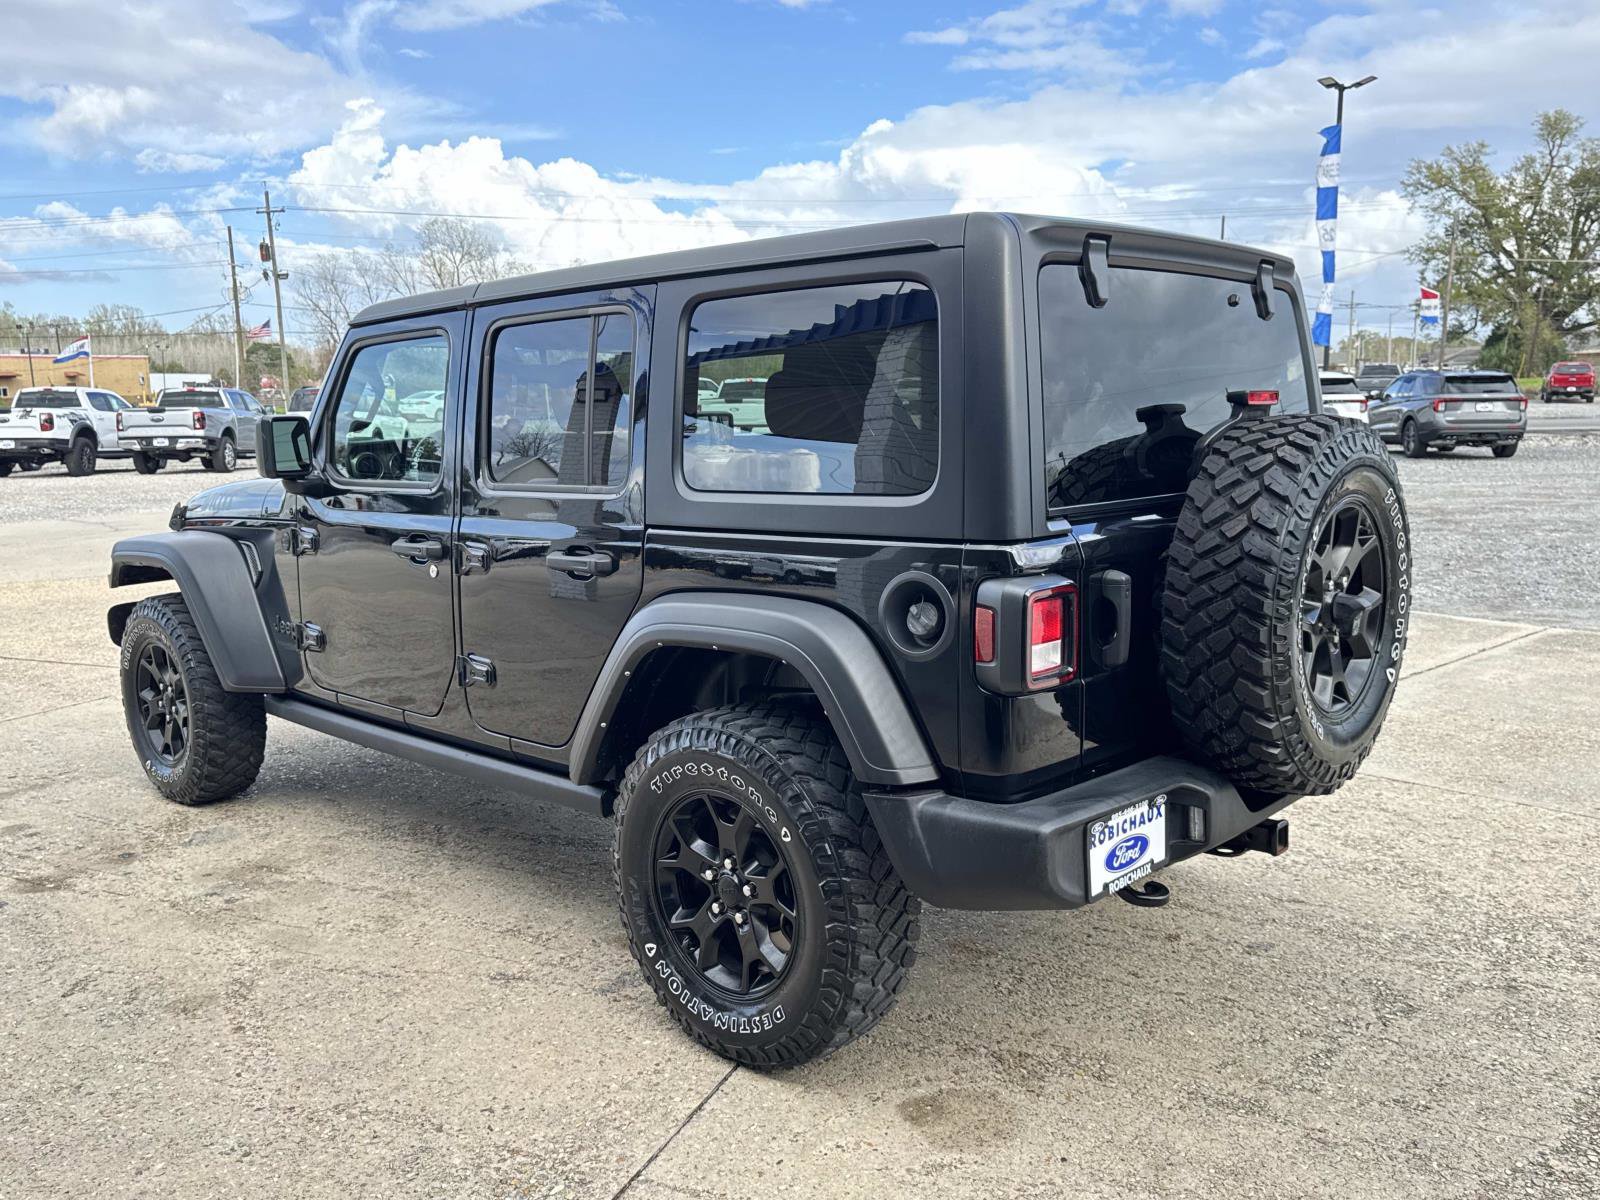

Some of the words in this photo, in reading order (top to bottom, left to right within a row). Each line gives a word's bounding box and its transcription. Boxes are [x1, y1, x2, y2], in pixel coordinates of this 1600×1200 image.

[1384, 487, 1409, 661] Firestone
[273, 615, 297, 641] Jeep
[650, 762, 778, 824] Firestone
[1089, 803, 1163, 850] ROBICHAUX
[1113, 839, 1141, 867] Ford
[1108, 863, 1152, 894] ROBICHAUX
[655, 960, 786, 1033] DESTINATION
